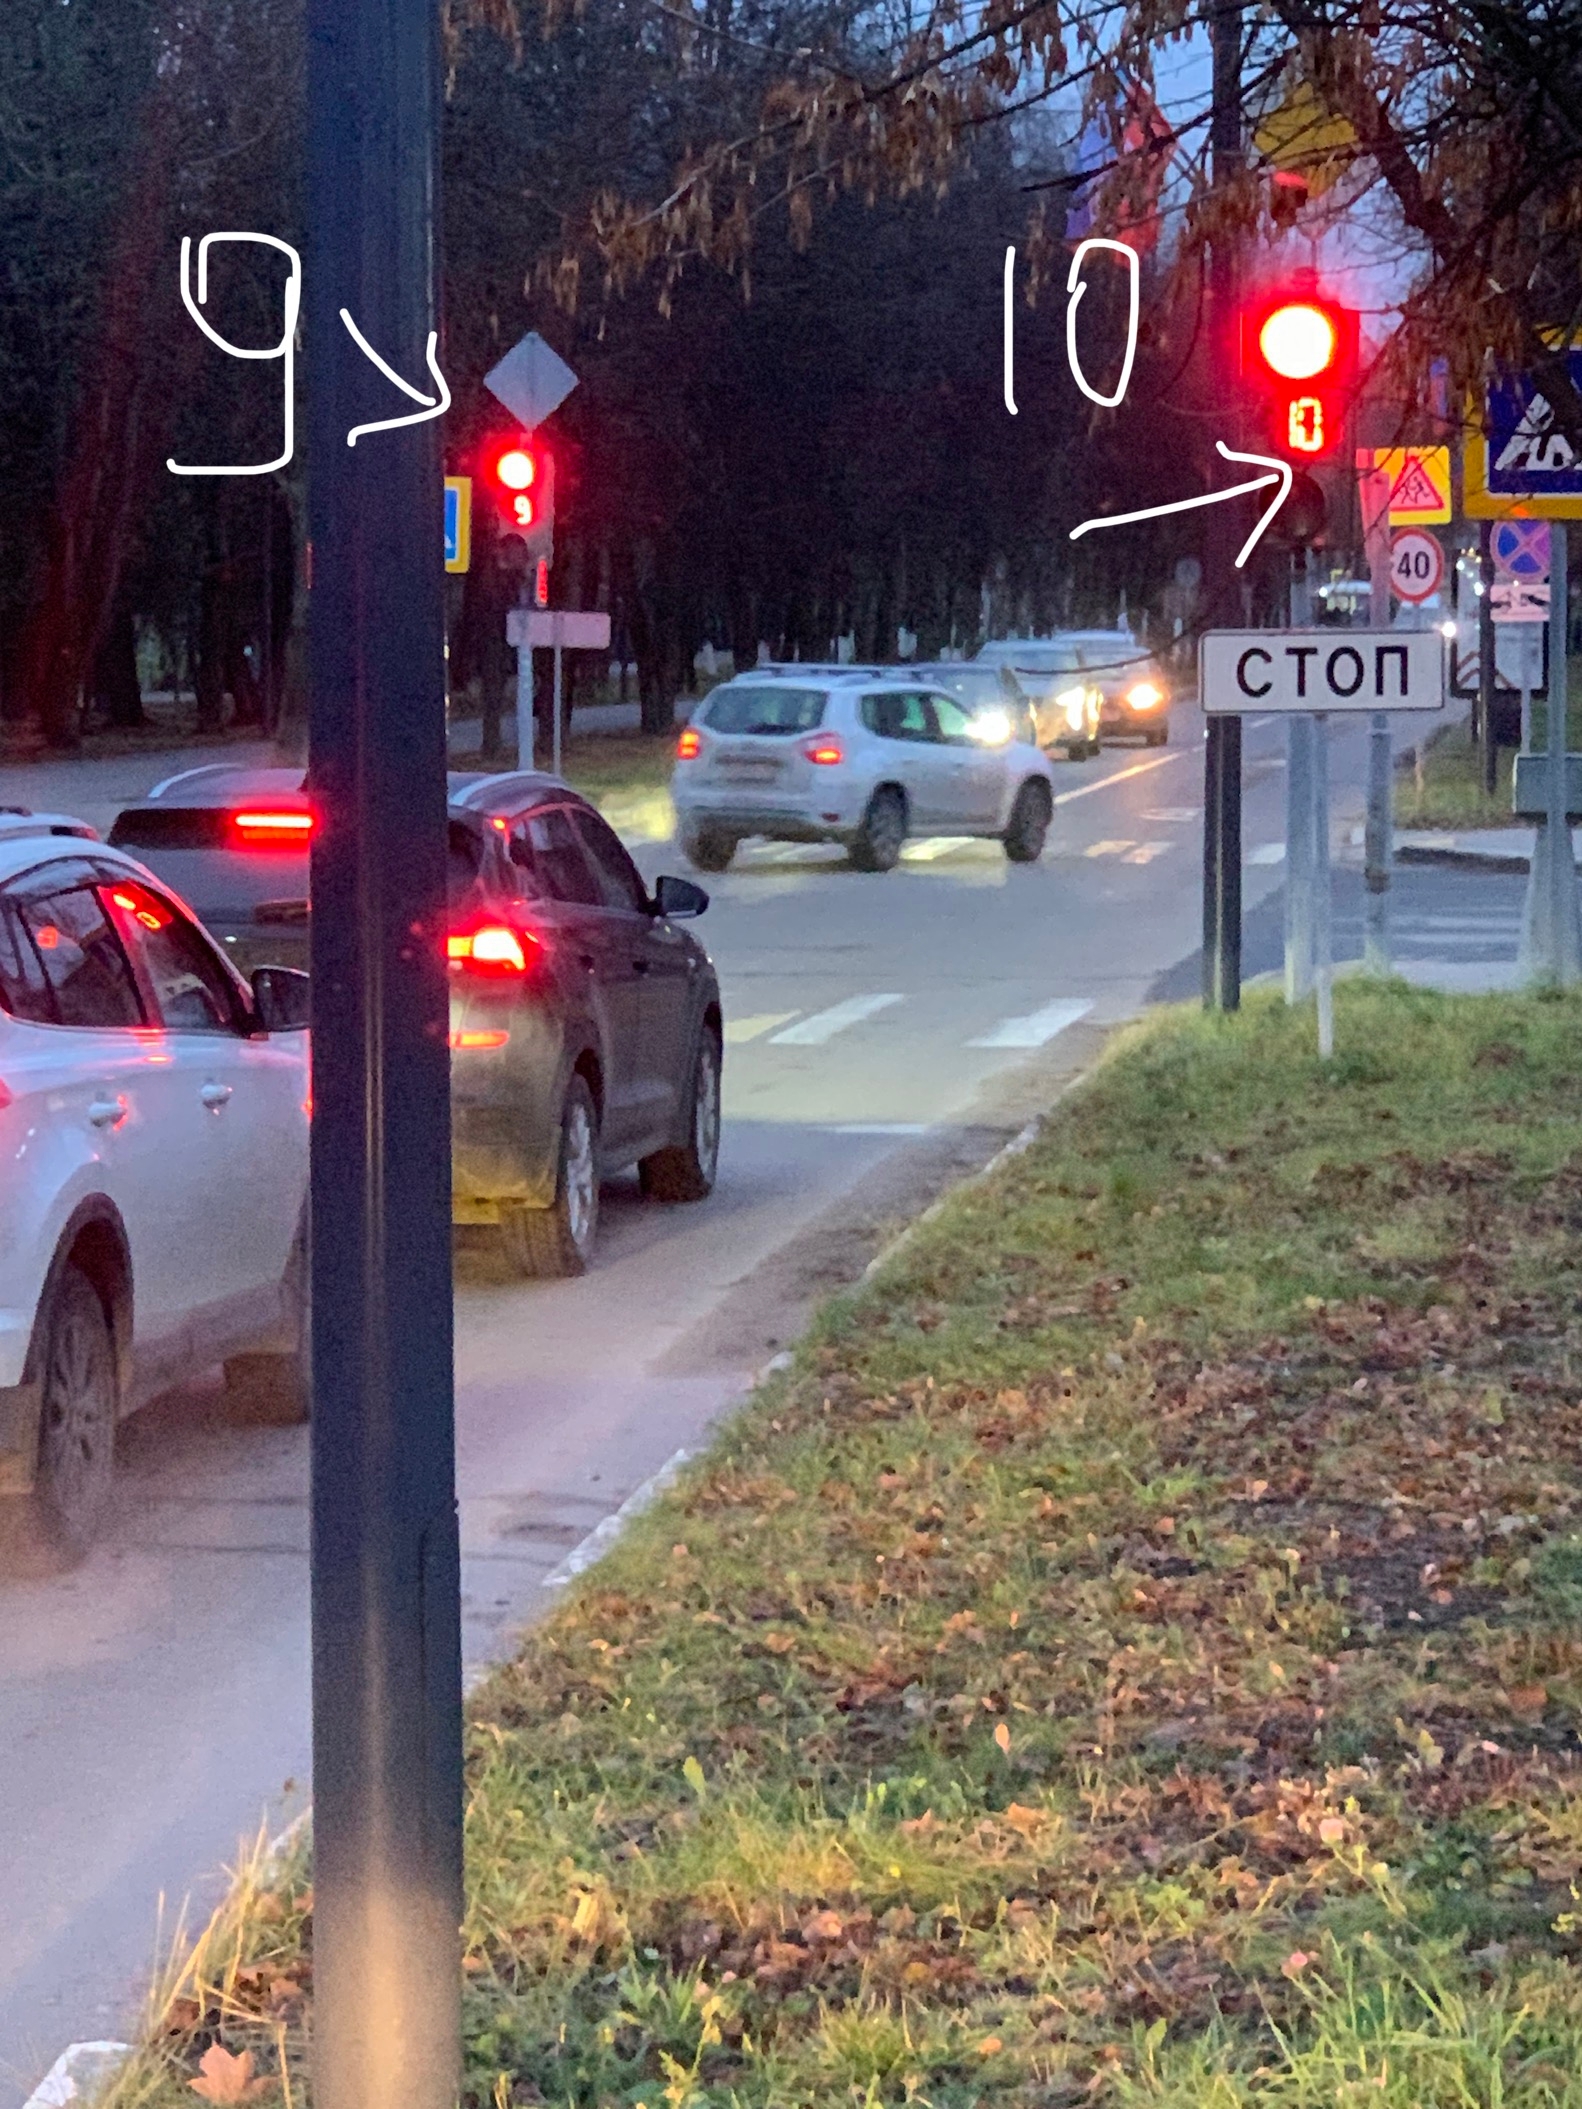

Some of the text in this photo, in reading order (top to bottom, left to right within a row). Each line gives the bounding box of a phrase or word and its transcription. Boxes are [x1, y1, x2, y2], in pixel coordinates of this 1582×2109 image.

[513, 495, 532, 525] 9
[1397, 551, 1430, 579] 40
[1236, 645, 1409, 698] СТОП
